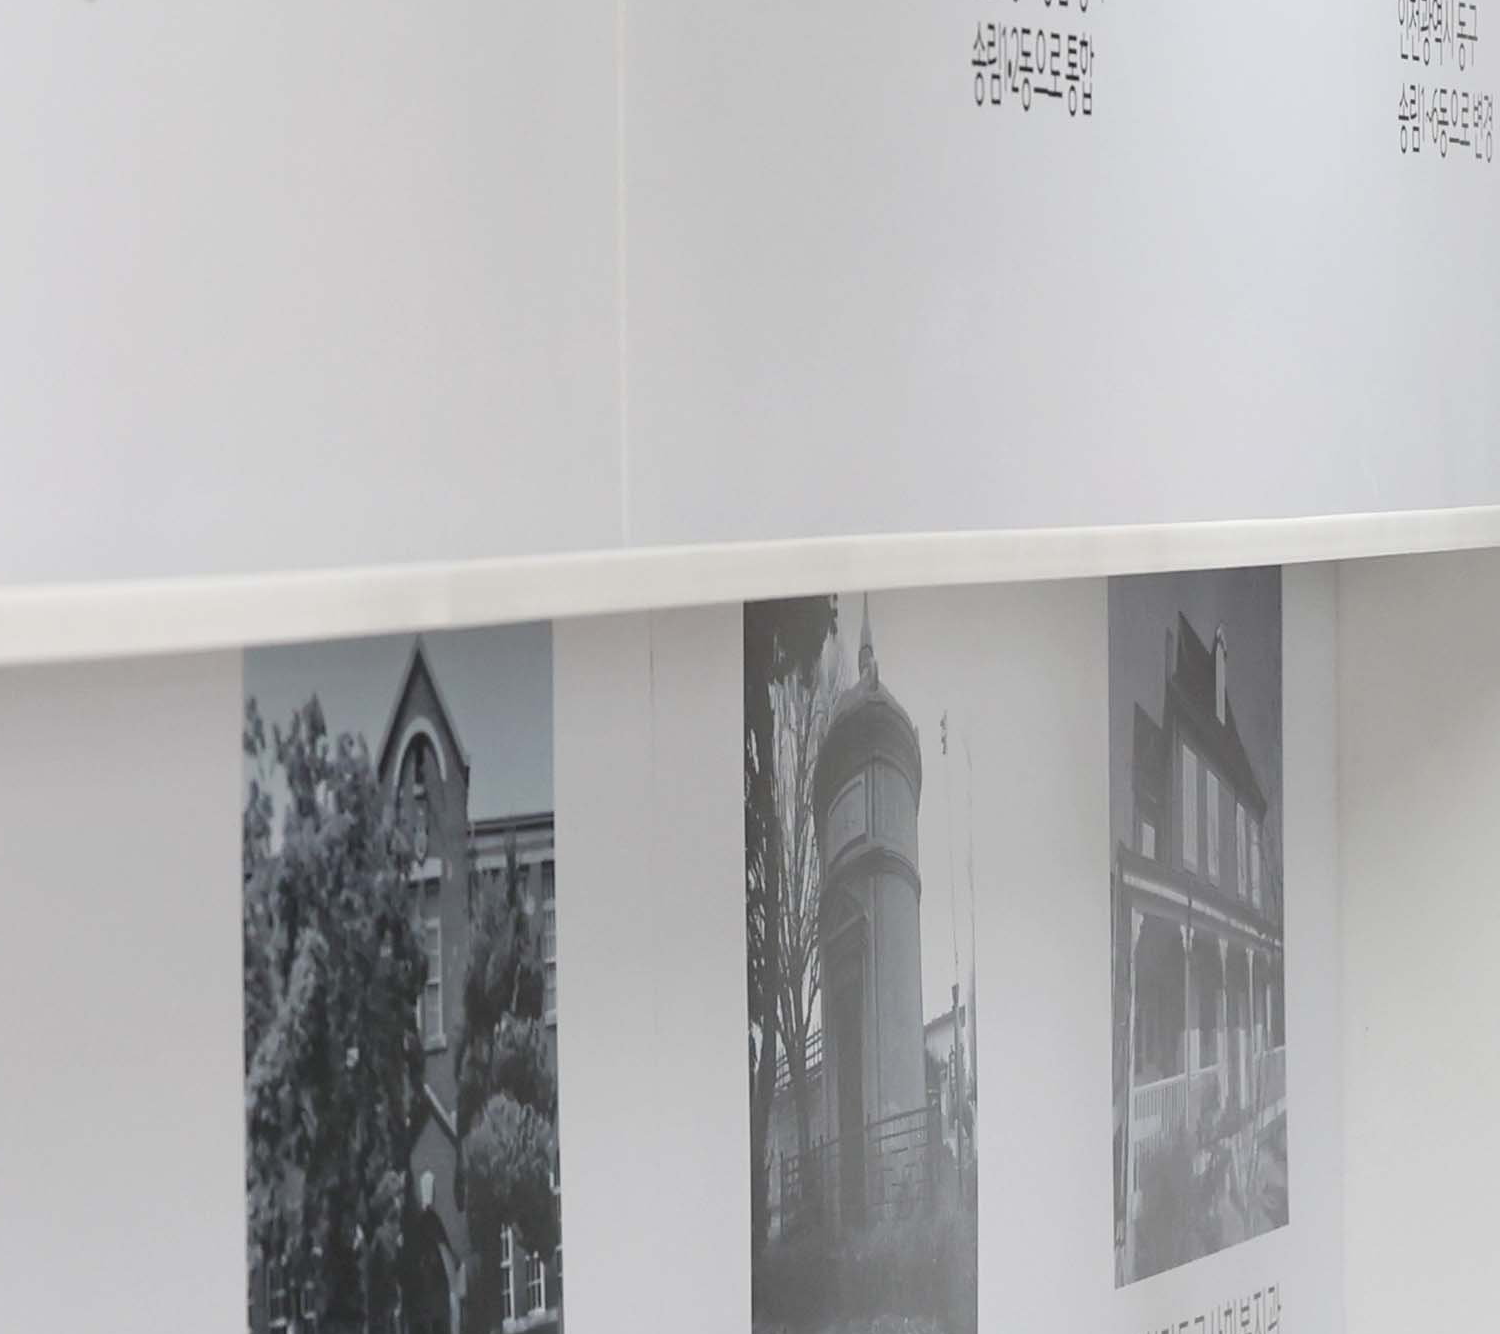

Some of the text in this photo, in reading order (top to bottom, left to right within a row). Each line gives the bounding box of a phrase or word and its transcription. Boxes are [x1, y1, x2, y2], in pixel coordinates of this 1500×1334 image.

[1065, 32, 1095, 118] 통합
[1456, 1, 1479, 72] 동구
[1398, 82, 1494, 164] 송림1~6동으로 변경
